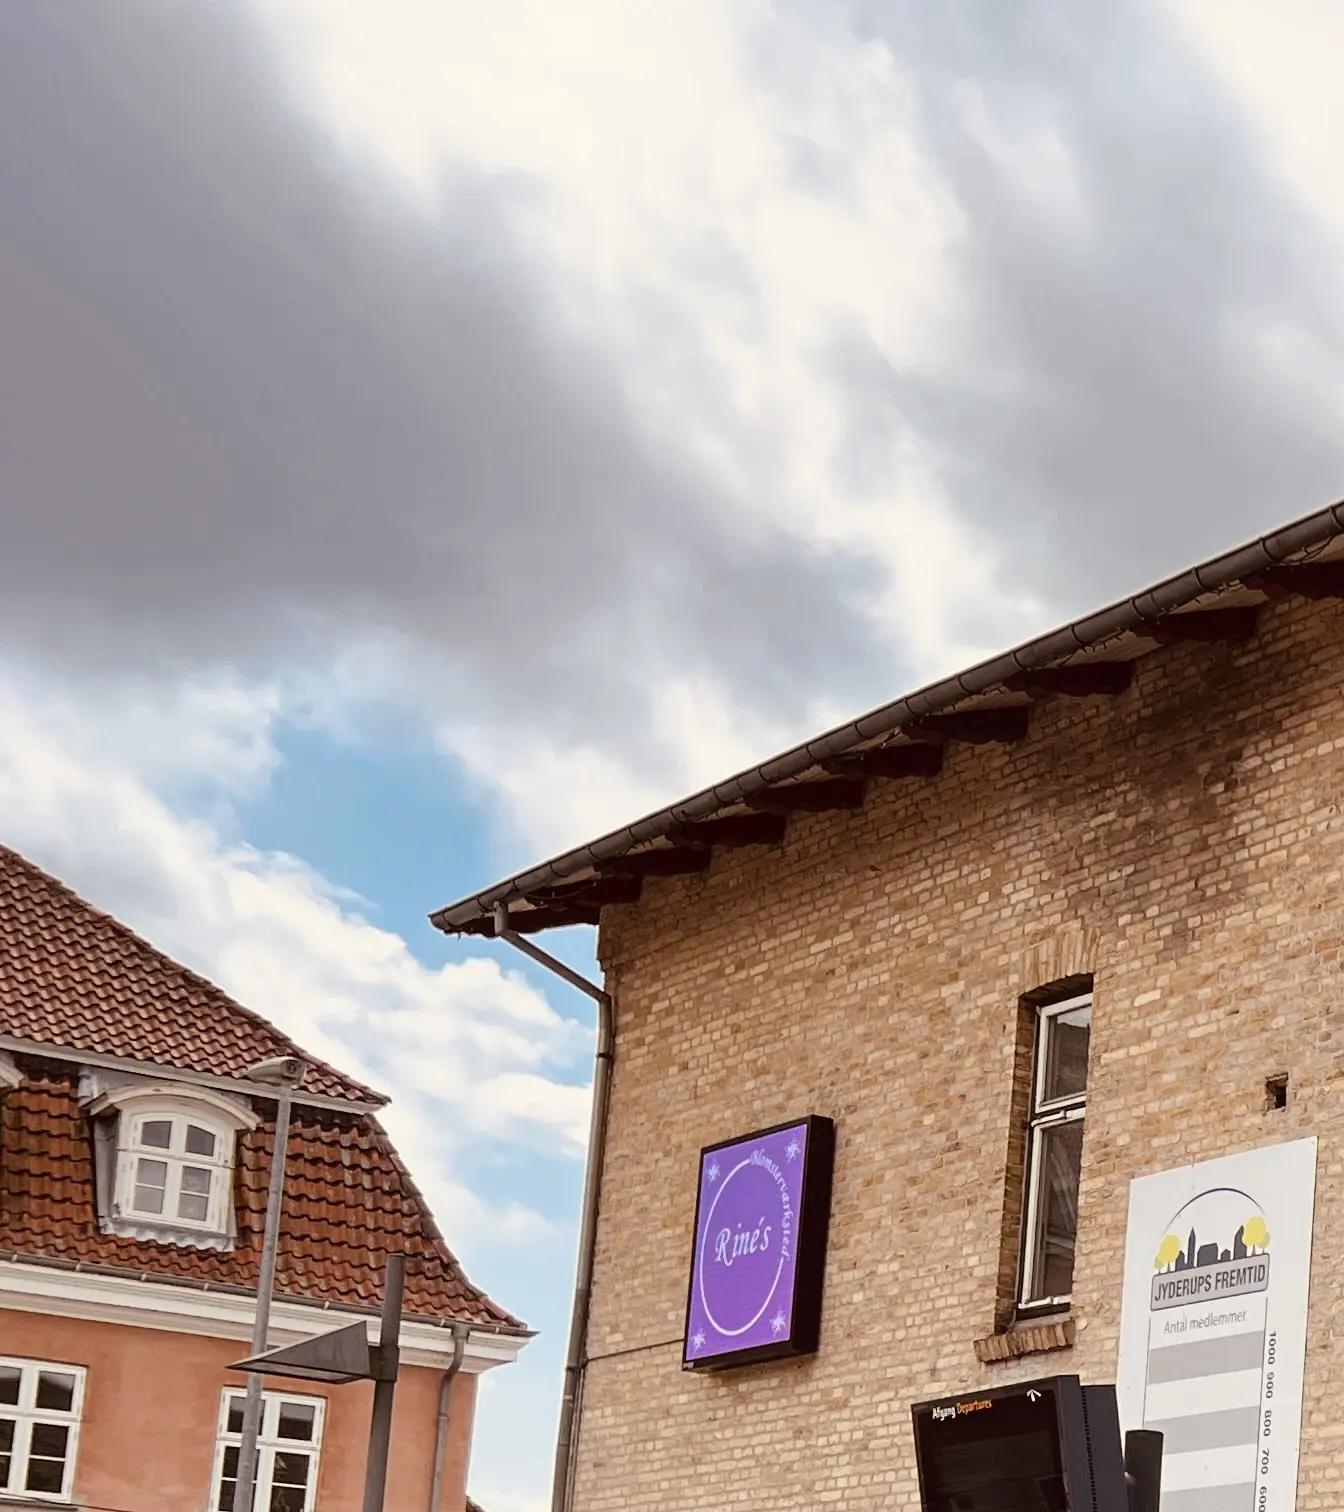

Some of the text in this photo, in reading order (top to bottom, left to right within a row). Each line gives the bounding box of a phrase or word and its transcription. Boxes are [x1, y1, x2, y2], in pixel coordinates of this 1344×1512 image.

[1153, 1264, 1266, 1302] JYDERUPS FREMTID
[1163, 1309, 1248, 1334] Antal medlemmer
[1267, 1331, 1277, 1365] 1000
[1266, 1372, 1275, 1399] 900
[1263, 1410, 1273, 1437] 800
[1260, 1450, 1270, 1475] 700
[1258, 1486, 1268, 1512] 600
